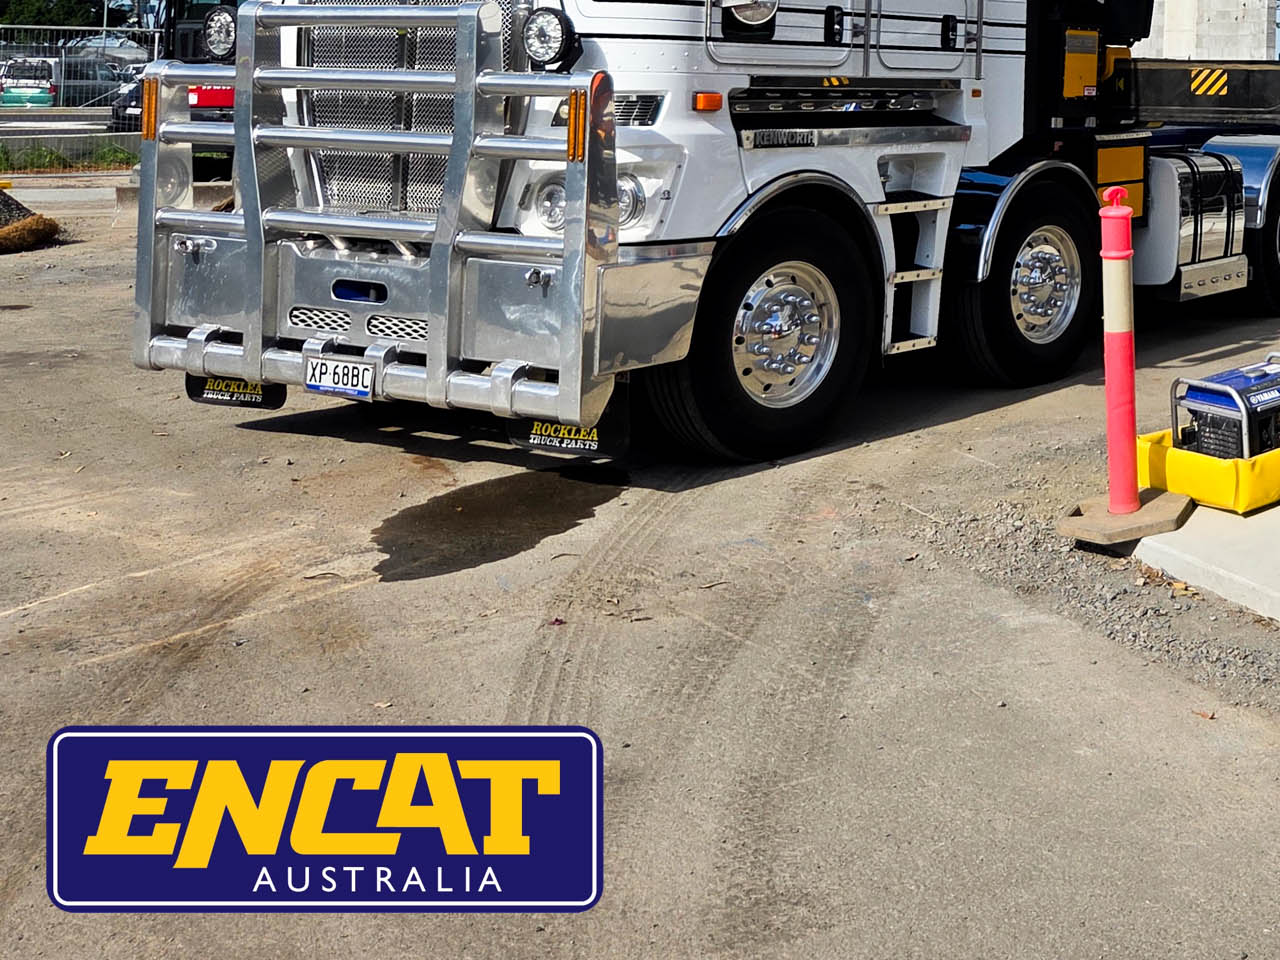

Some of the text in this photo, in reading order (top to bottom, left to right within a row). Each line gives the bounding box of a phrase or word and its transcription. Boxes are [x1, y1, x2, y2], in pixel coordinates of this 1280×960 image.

[755, 130, 814, 146] KENWORTH
[205, 378, 263, 395] ROCKLEA
[203, 390, 263, 403] TRUCK PARTS
[1256, 390, 1280, 403] YAMAHA
[531, 421, 599, 441] ROCKLEA
[529, 434, 599, 450] TRUCK PARTS
